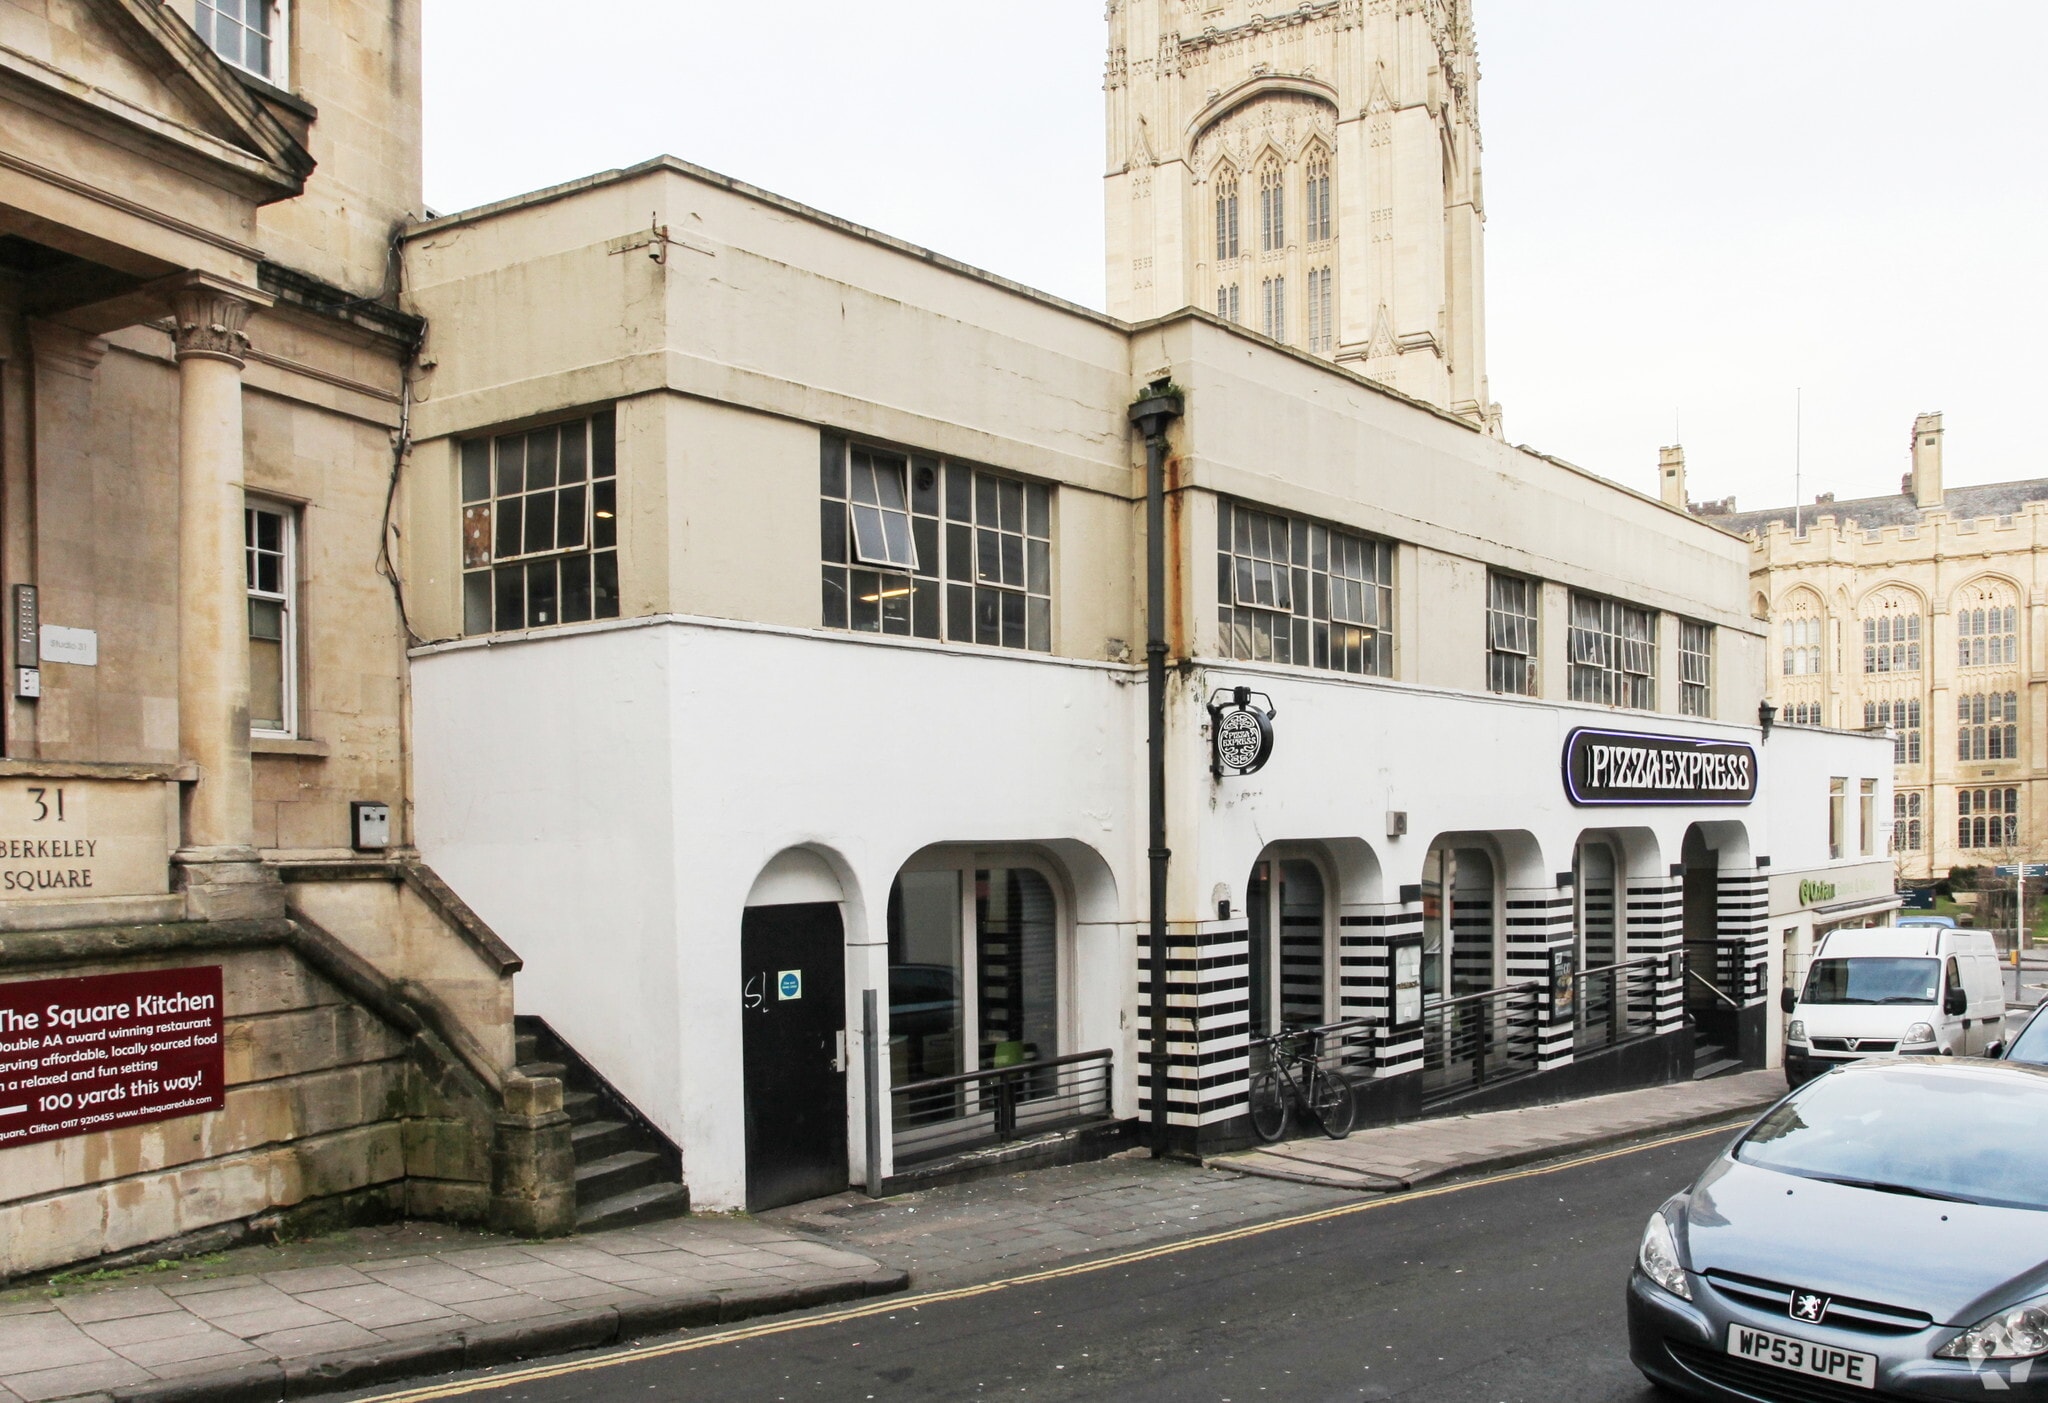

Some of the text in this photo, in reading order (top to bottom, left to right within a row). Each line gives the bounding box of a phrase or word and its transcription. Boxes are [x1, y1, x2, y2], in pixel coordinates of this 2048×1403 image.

[49, 639, 77, 650] Studio
[1223, 736, 1256, 747] EXPRESS
[1229, 730, 1250, 739] PIZZA
[1591, 744, 1749, 791] PIZZAEXPRESS
[27, 787, 65, 822] 31
[0, 839, 97, 859] BERKELEY
[4, 868, 93, 891] SQUARE
[47, 1003, 130, 1029] Square
[136, 992, 215, 1017] Kitchen
[42, 1034, 63, 1048] AA
[66, 1029, 106, 1044] award
[108, 1023, 153, 1039] winning
[156, 1017, 211, 1034] restaurant
[41, 1049, 109, 1067] affordable,
[111, 1043, 148, 1058] locally
[150, 1036, 191, 1052] sourced
[194, 1033, 218, 1047] food
[8, 1080, 18, 1091] a
[21, 1070, 68, 1088] relaxed
[71, 1067, 95, 1082] and
[98, 1065, 118, 1078] fun
[120, 1060, 159, 1075] setting
[38, 1070, 203, 1112] 100 yards this way!
[29, 1121, 59, 1135] Clifton
[61, 1117, 78, 1129] 0117
[80, 1112, 115, 1126] 9210455
[116, 1096, 212, 1119] www.thesquareclub.com
[1740, 1329, 1864, 1382] WP53 UPE
